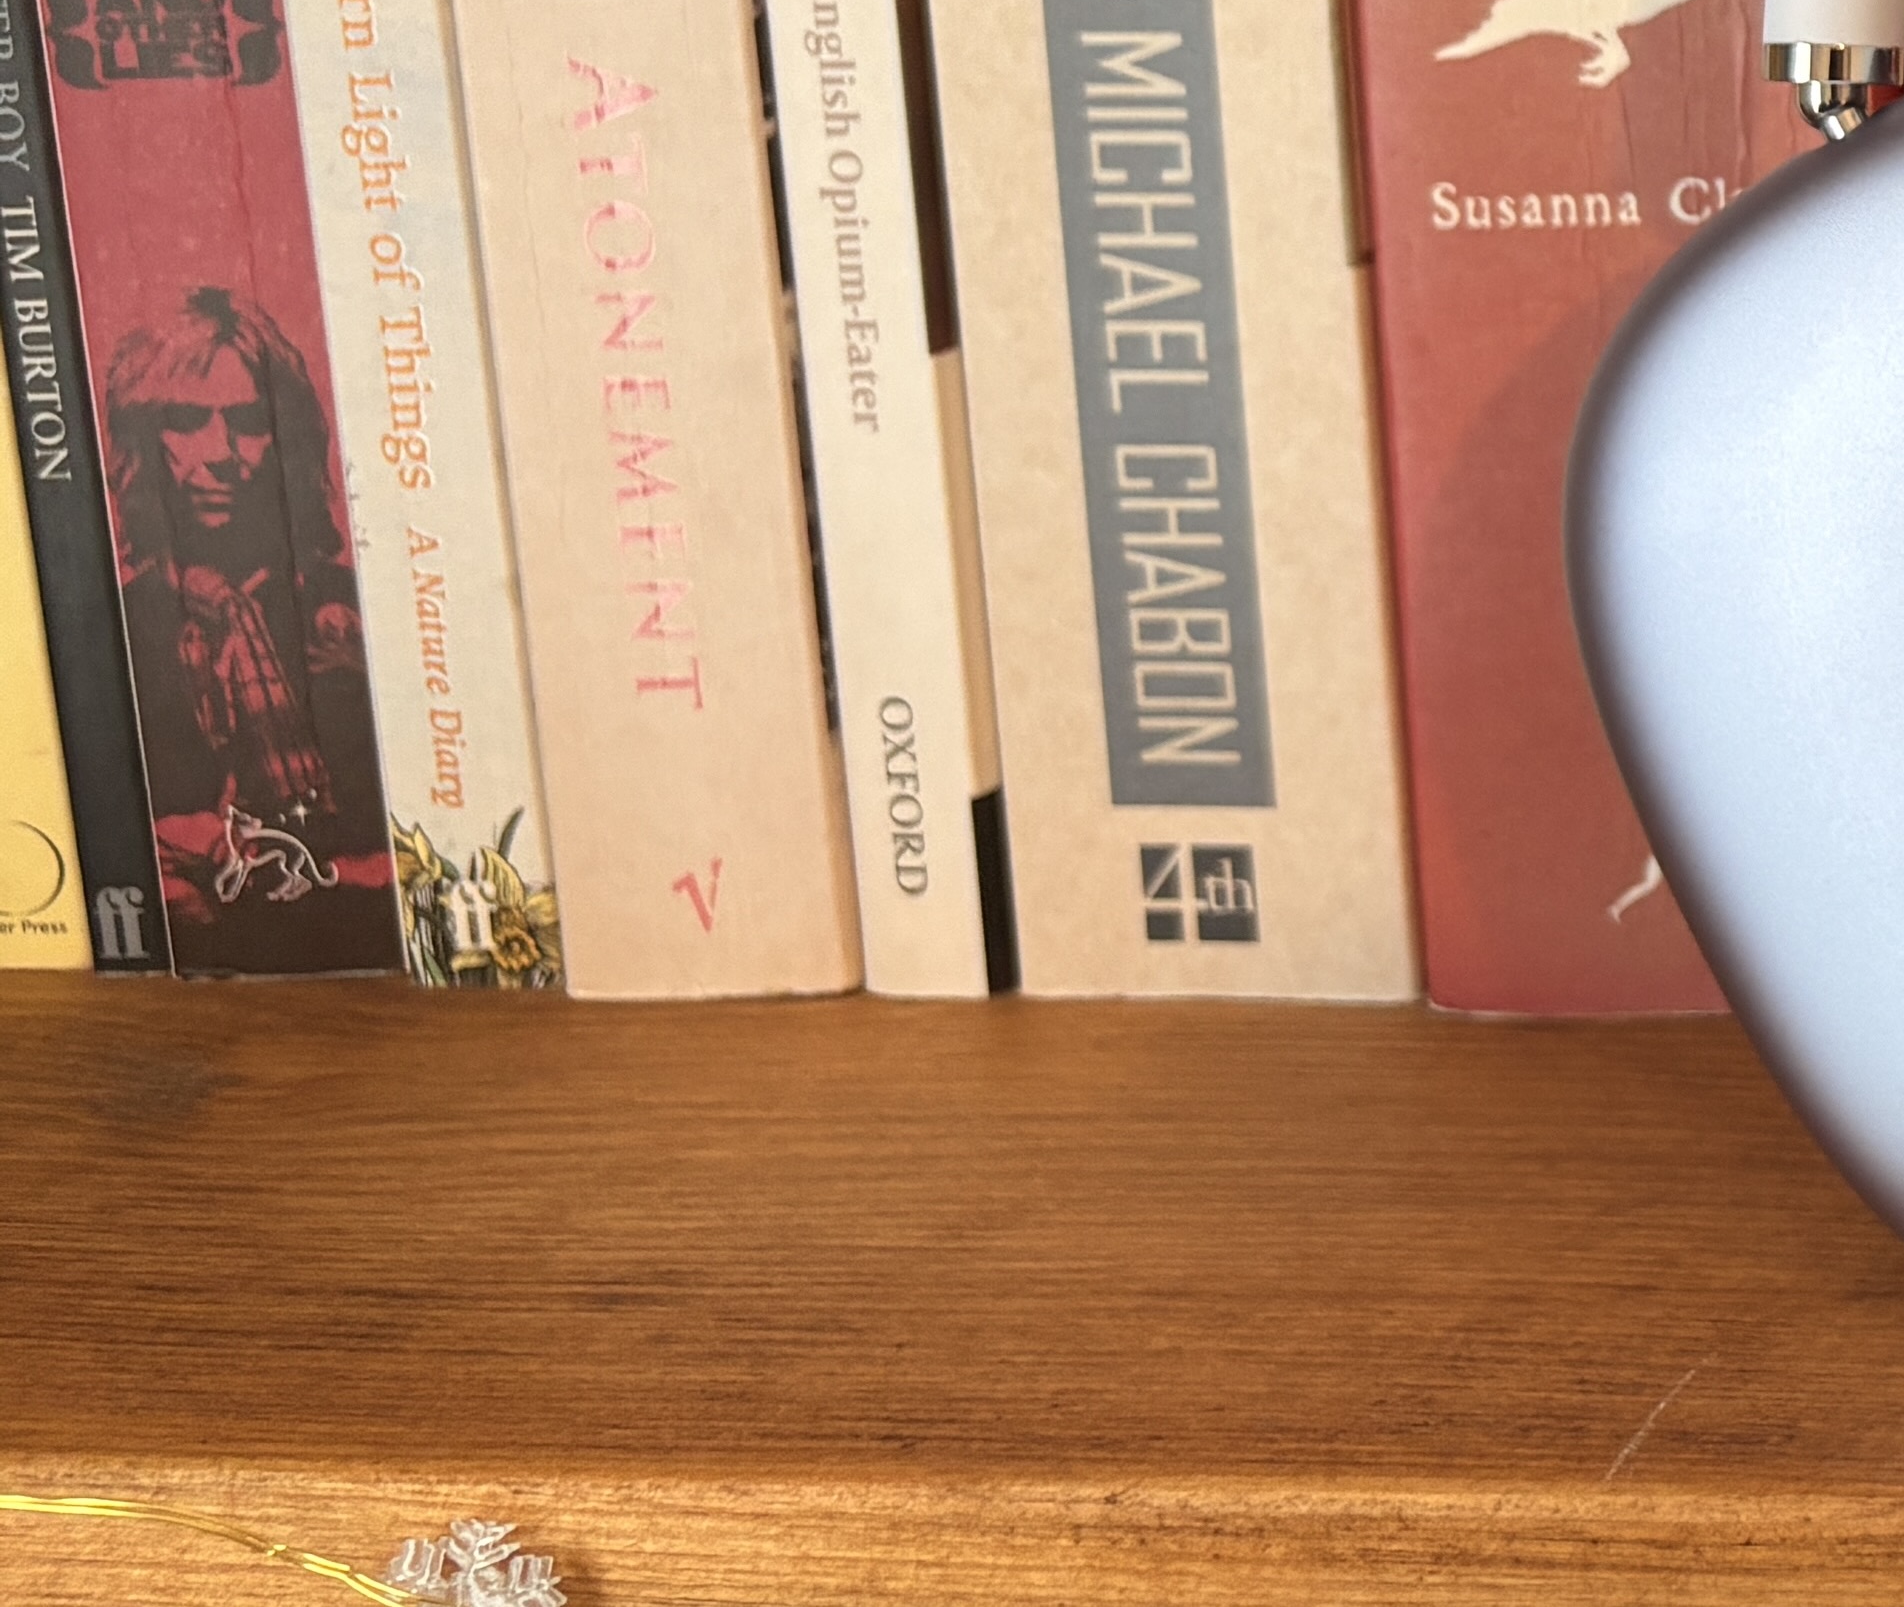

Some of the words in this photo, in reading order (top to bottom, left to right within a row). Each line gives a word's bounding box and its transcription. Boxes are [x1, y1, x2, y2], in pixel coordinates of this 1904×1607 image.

[341, 72, 411, 213] Light
[1429, 180, 1642, 231] Susanna
[1668, 175, 1744, 225] Cl
[0, 194, 46, 284] TIM
[369, 234, 425, 293] of
[819, 150, 880, 433] Opium-Eater
[1080, 30, 1209, 414] MICHAEL
[14, 297, 73, 483] BURTON
[378, 304, 437, 492] Things
[567, 54, 703, 711] ATONEMENT
[406, 525, 440, 560] A
[1114, 444, 1242, 765] CHABON
[410, 568, 454, 694] Nature
[427, 706, 466, 811] Diary
[878, 696, 929, 897] OXFORD
[22, 919, 69, 936] Press
